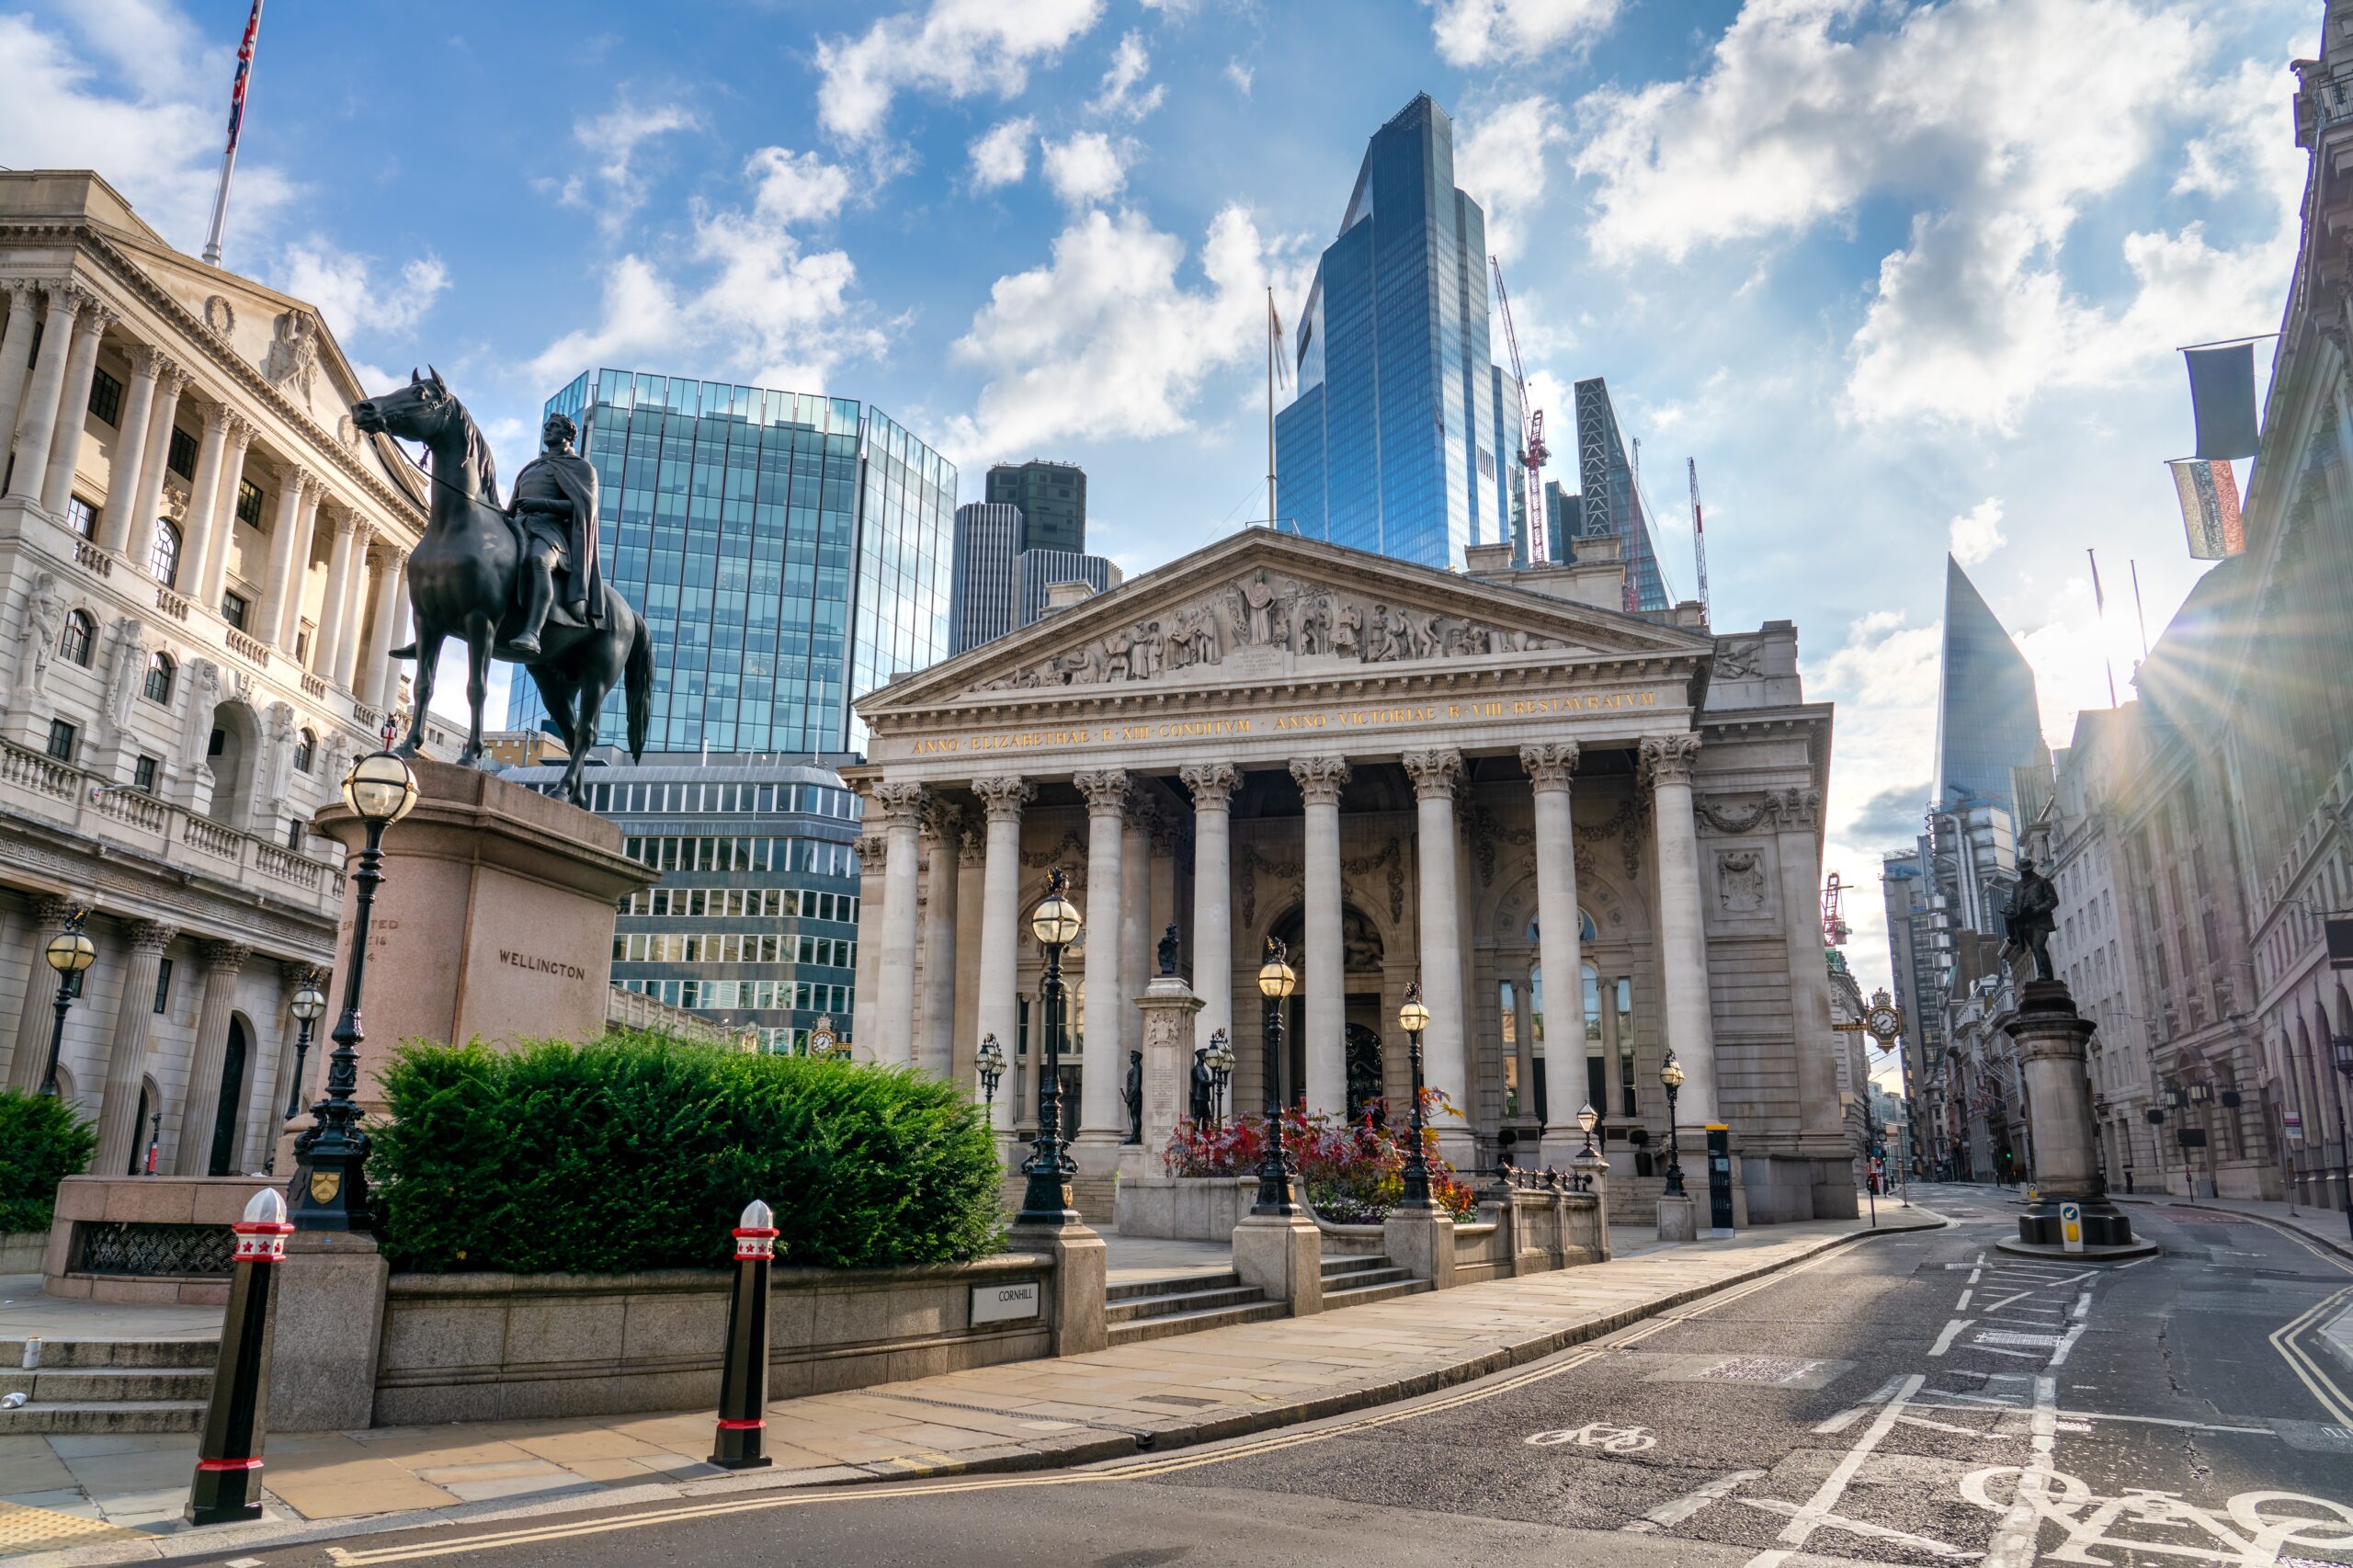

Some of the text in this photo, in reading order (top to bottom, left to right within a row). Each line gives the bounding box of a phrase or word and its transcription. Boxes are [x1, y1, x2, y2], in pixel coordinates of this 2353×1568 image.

[911, 691, 1654, 755] ANNO ELIZABETHAE R XIII CONDITVM ANNO VICTORIAE R VIII RESTAVRATVM
[342, 919, 399, 931] ERTED
[998, 1289, 1033, 1301] CORNHILL
